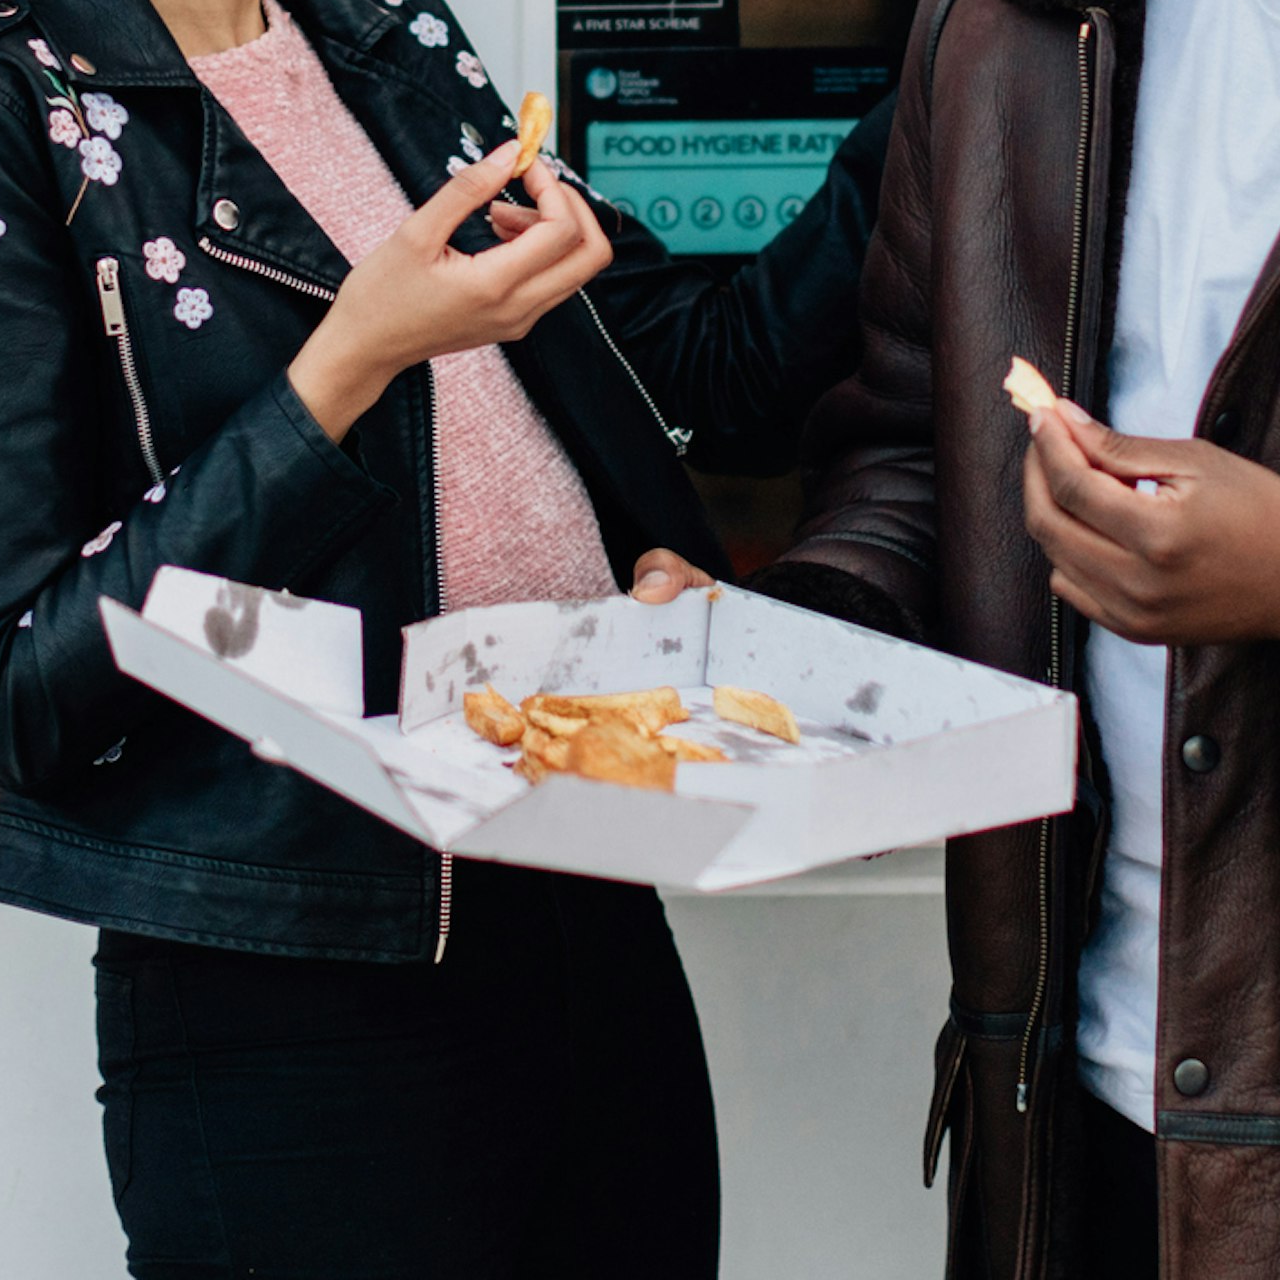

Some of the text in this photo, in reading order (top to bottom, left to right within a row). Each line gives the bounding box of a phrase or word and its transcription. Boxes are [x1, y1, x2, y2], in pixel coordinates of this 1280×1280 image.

[573, 17, 700, 31] A FIVE STAR SCHEME
[604, 135, 676, 156] FOOD
[682, 133, 782, 155] HYGIENE
